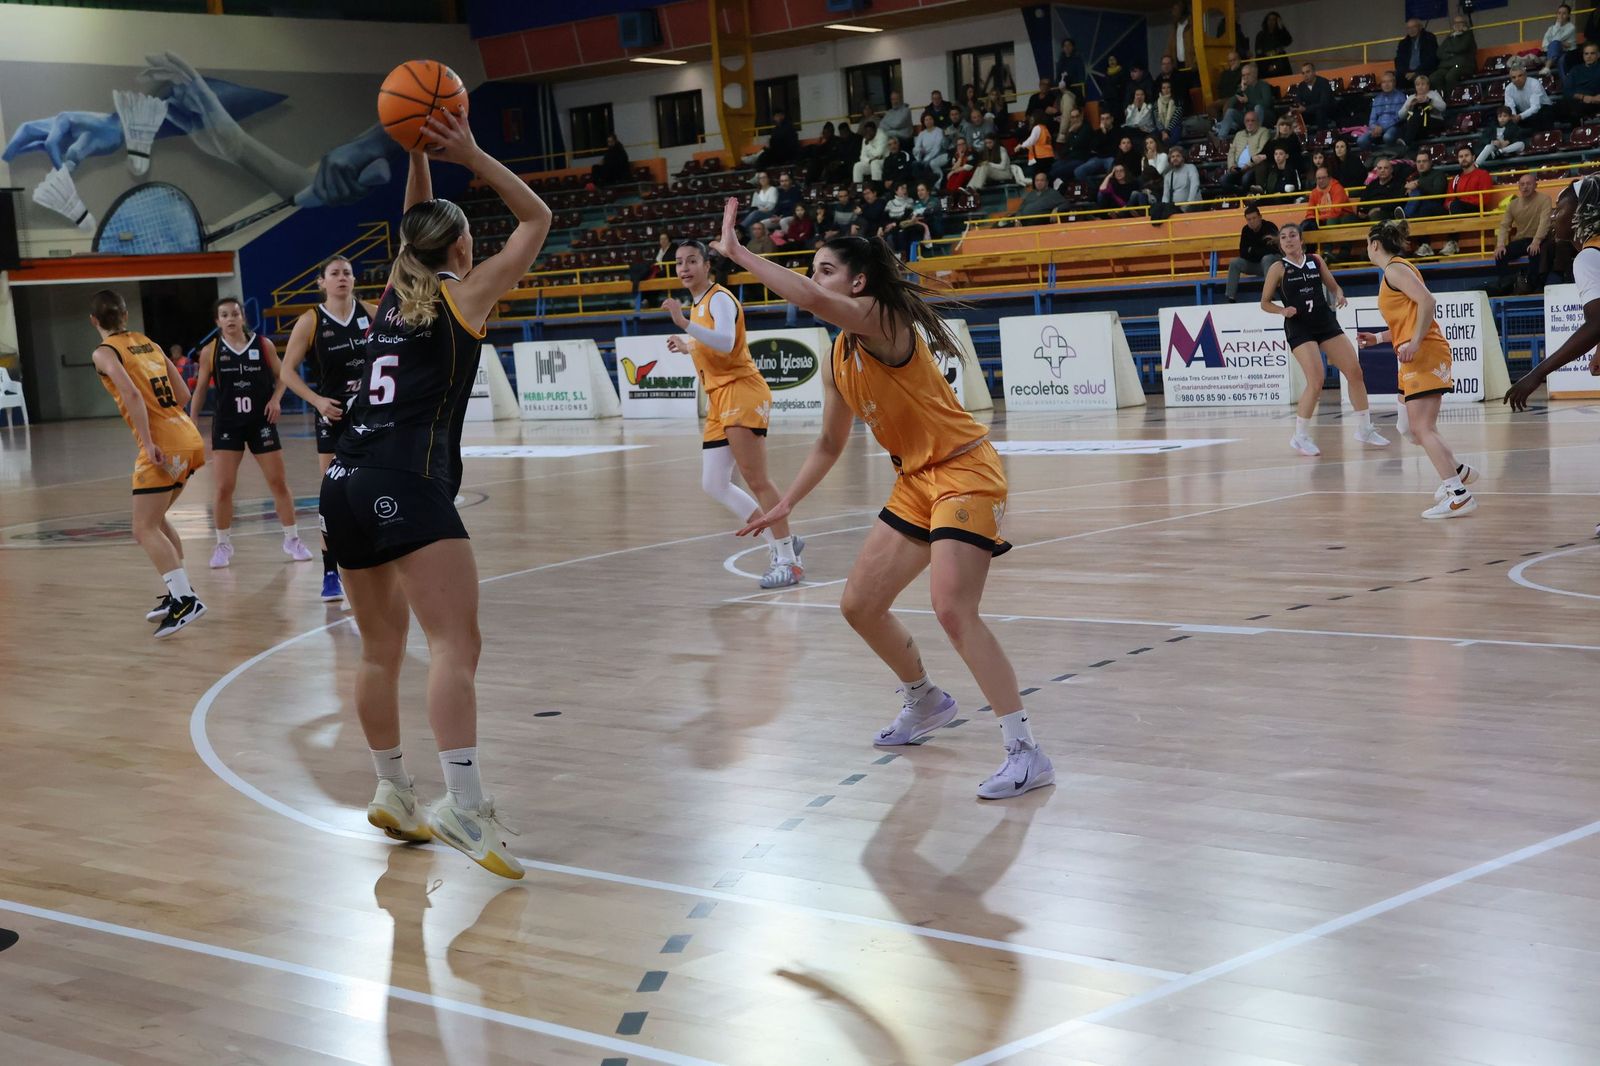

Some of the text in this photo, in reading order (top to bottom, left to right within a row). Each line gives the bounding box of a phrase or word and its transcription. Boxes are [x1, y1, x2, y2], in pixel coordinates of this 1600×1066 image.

[1544, 133, 1550, 142] 7
[1305, 300, 1314, 312] 7
[1446, 303, 1475, 318] FELIPE
[1563, 304, 1583, 312] CAMIN
[1446, 323, 1475, 340] GÓMEZ
[1551, 324, 1570, 332] Morales
[1453, 347, 1477, 361] RERO
[780, 350, 813, 374] Iglesias
[369, 354, 399, 405] 5
[149, 375, 177, 408] 55
[1011, 379, 1106, 395] recoletas salud
[573, 392, 588, 401] S.L.
[235, 396, 252, 413] 10
[524, 403, 588, 411] SEÑALIZACIONES
[773, 399, 822, 411] noiglesias.com
